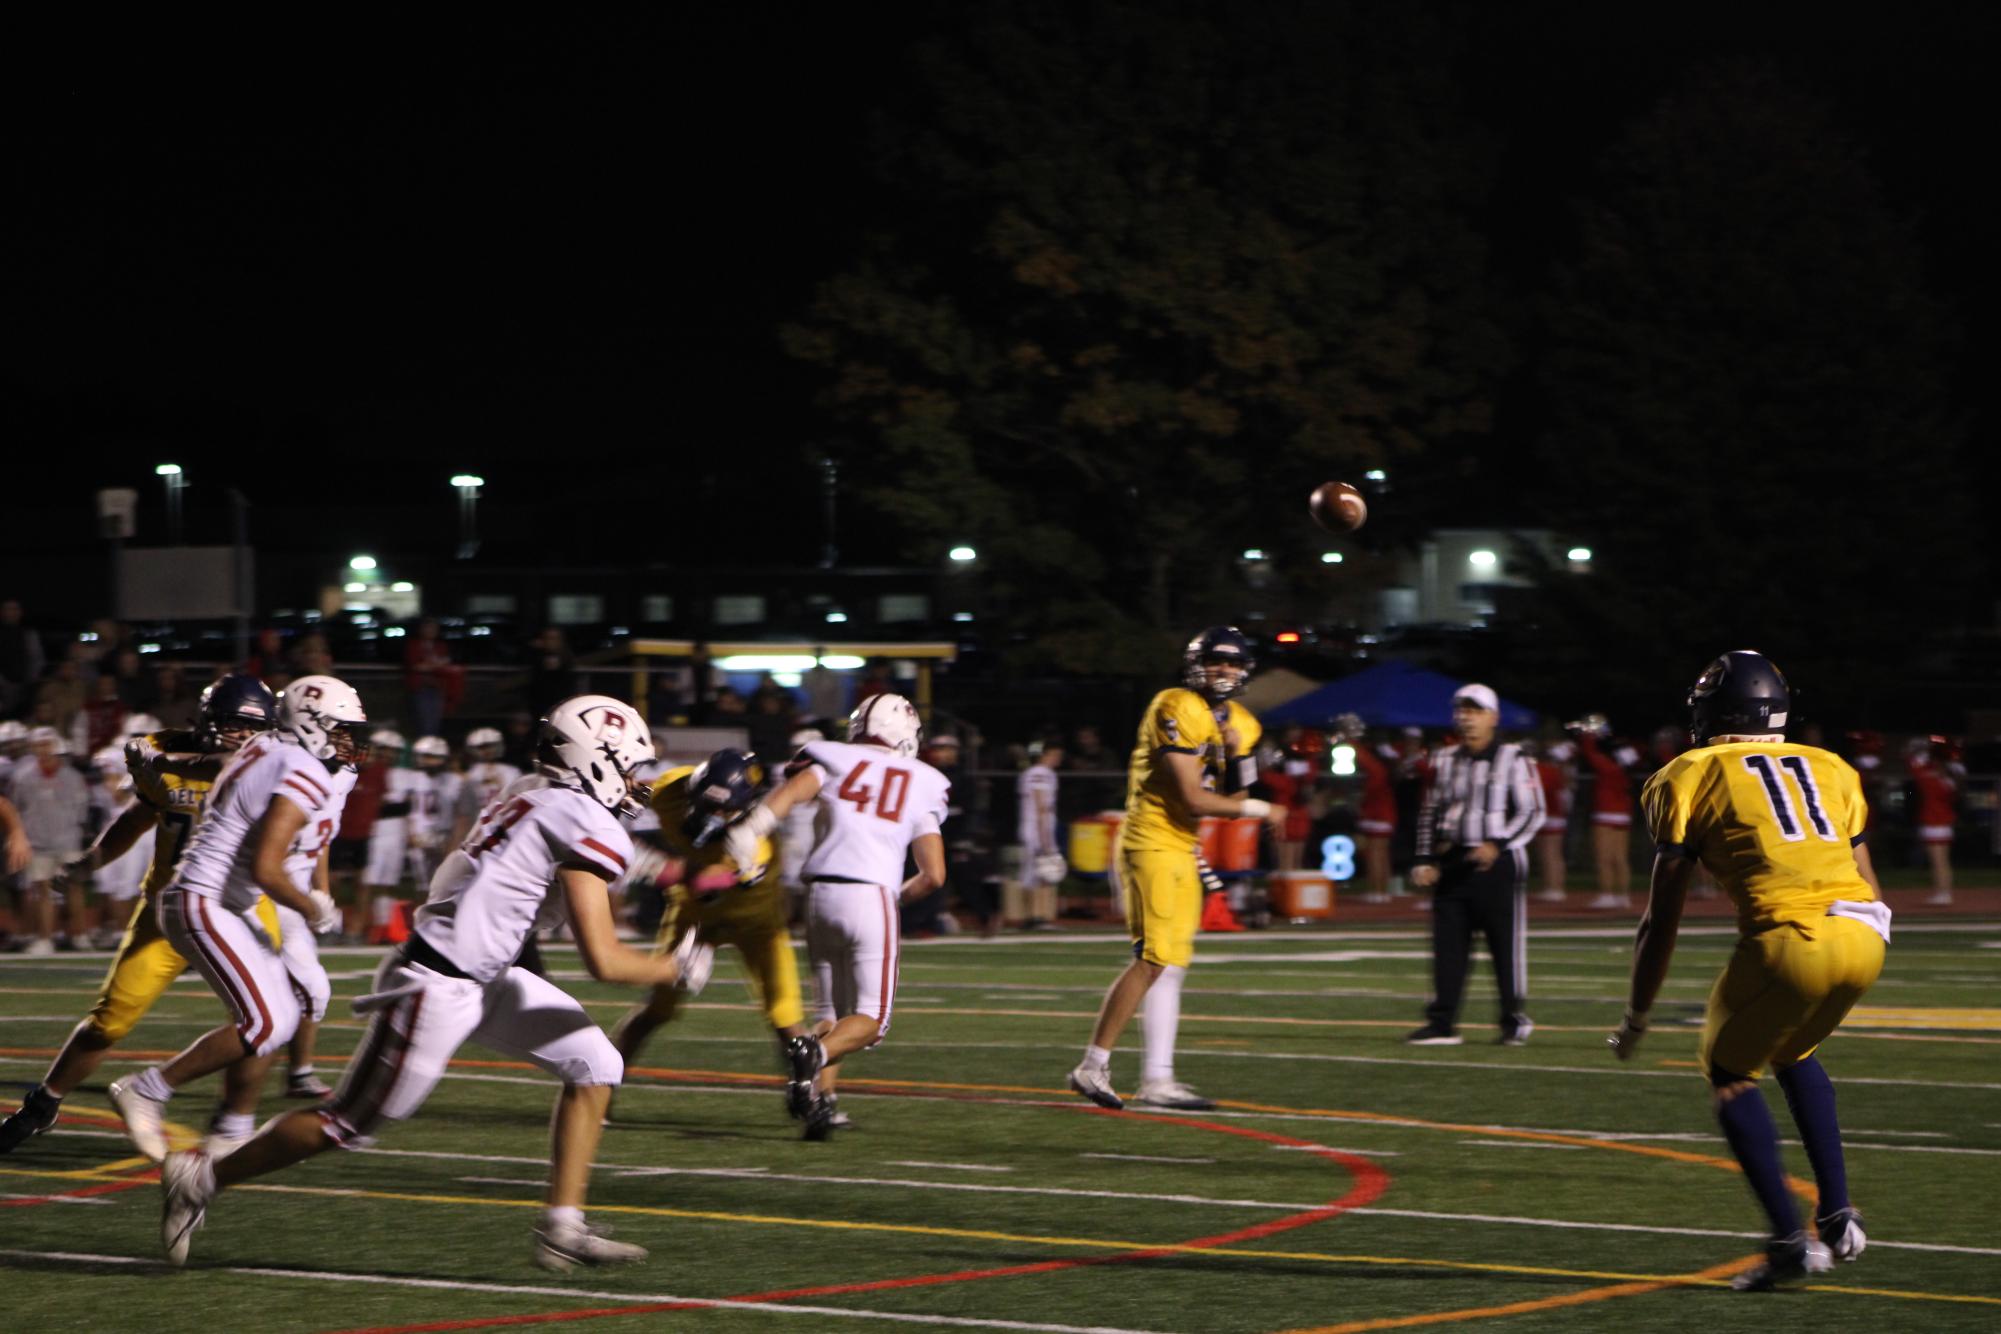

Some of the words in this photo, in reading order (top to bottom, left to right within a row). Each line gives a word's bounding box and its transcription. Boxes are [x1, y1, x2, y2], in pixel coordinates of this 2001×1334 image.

[1759, 705, 1770, 717] 11
[838, 759, 911, 823] 40
[1742, 753, 1840, 842] 11
